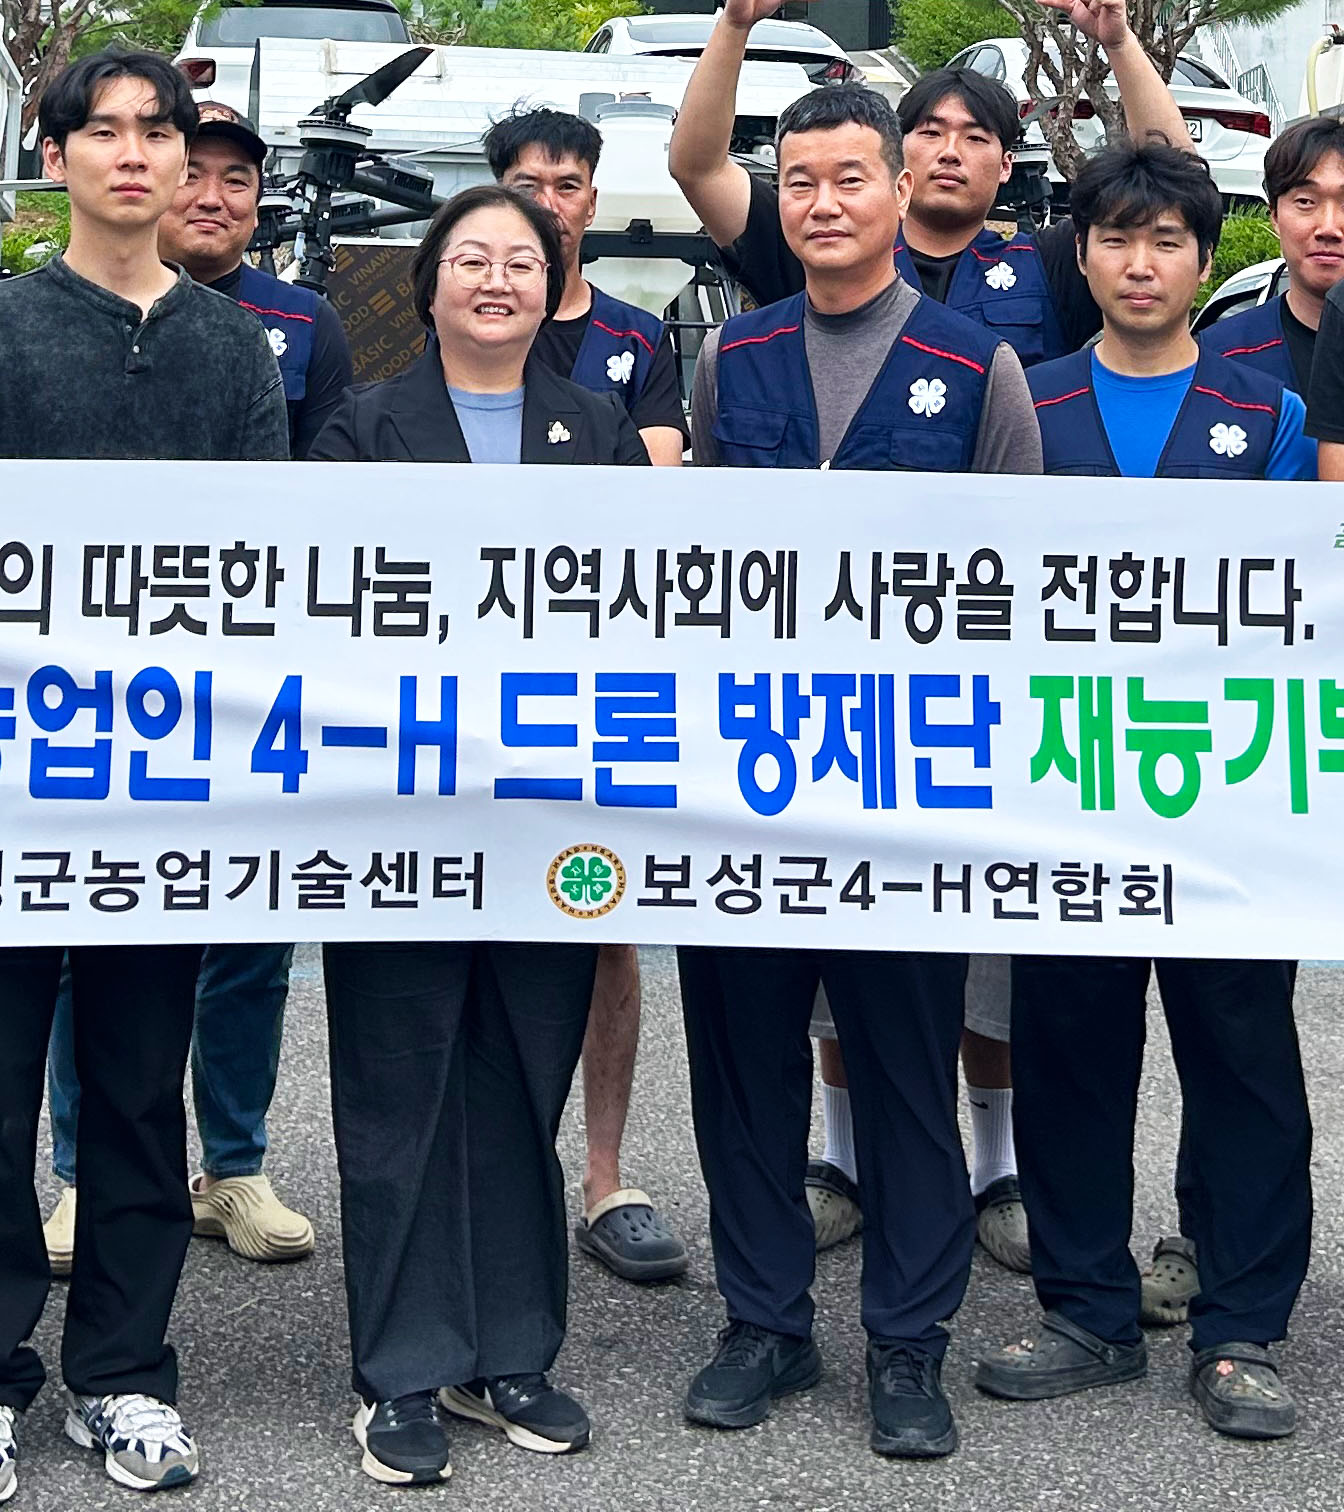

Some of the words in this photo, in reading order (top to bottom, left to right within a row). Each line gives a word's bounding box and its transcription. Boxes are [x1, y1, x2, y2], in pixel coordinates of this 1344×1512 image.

[81, 540, 286, 637] 따뜻한
[305, 544, 450, 645] 나눔,
[476, 544, 799, 640] 지역사회에
[823, 547, 1015, 645] 사랑을
[1040, 551, 1315, 647] 전합니다.
[250, 674, 460, 797] 4-H
[493, 672, 681, 809] 드론
[718, 672, 1002, 817] 방제단
[636, 852, 1175, 926] 보성군4-H연합회
